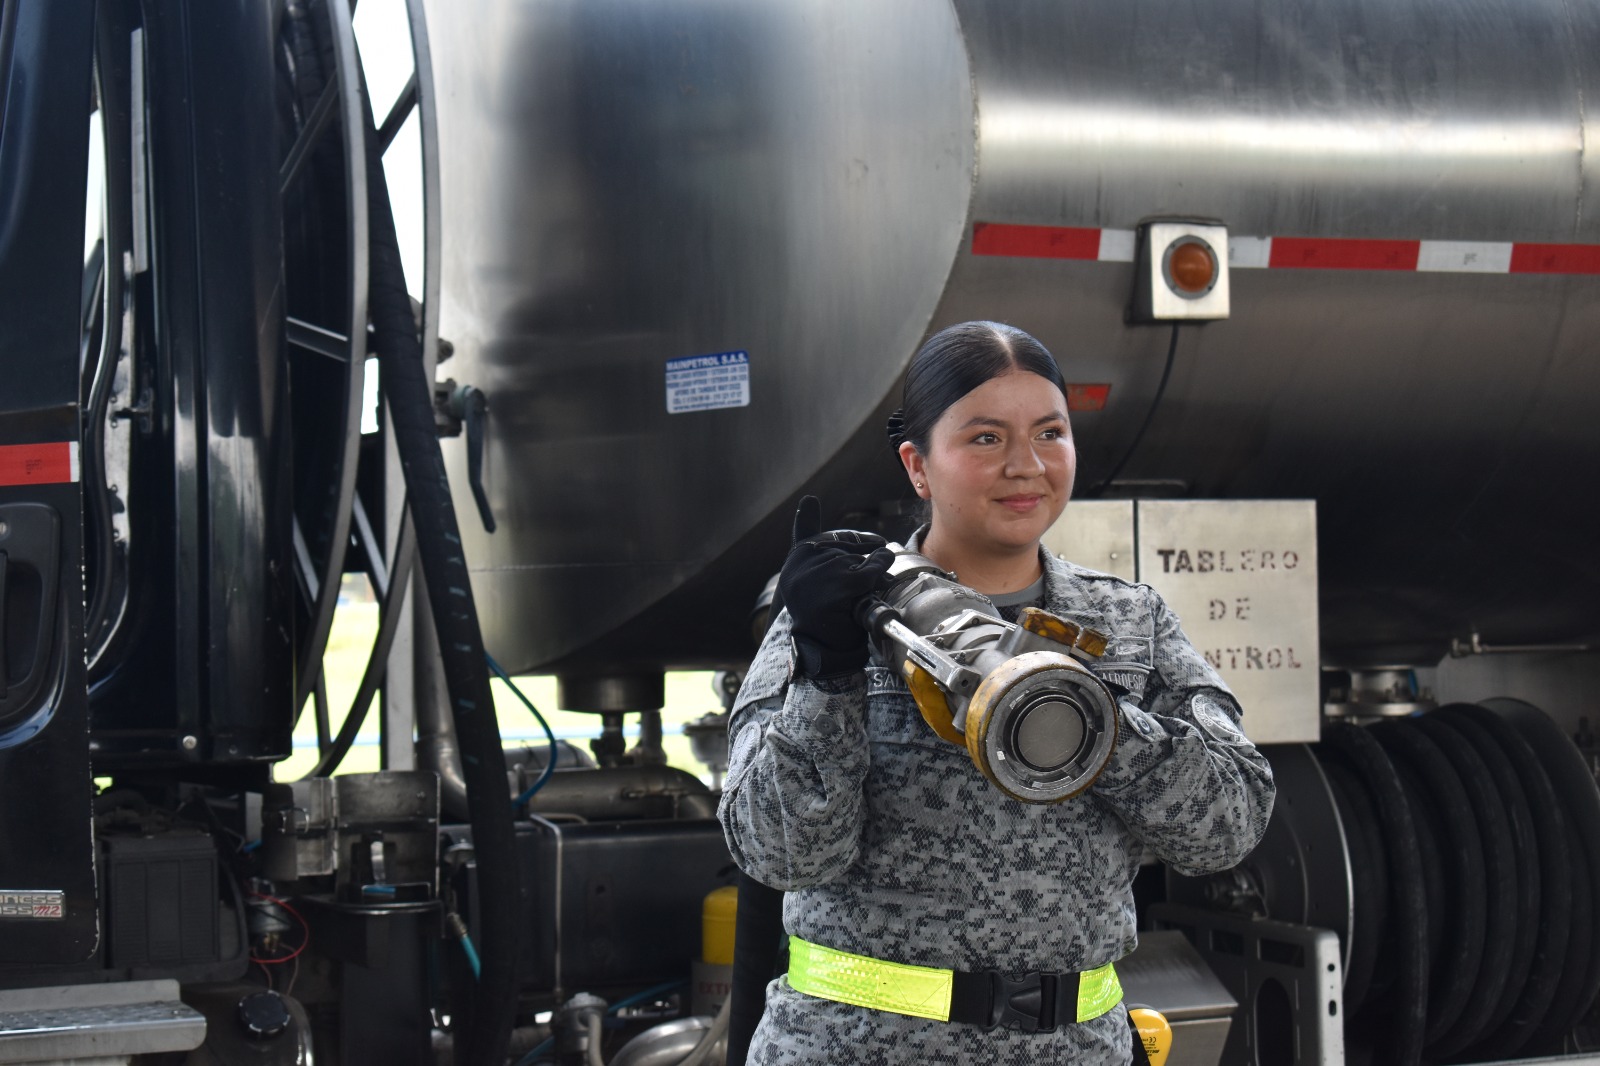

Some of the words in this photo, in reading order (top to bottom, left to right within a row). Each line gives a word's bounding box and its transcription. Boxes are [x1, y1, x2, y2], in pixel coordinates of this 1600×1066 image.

[666, 357, 719, 371] MAINPETROL
[1157, 549, 1299, 573] TABLERO
[1209, 597, 1251, 621] DE
[1204, 646, 1301, 670] NTROL
